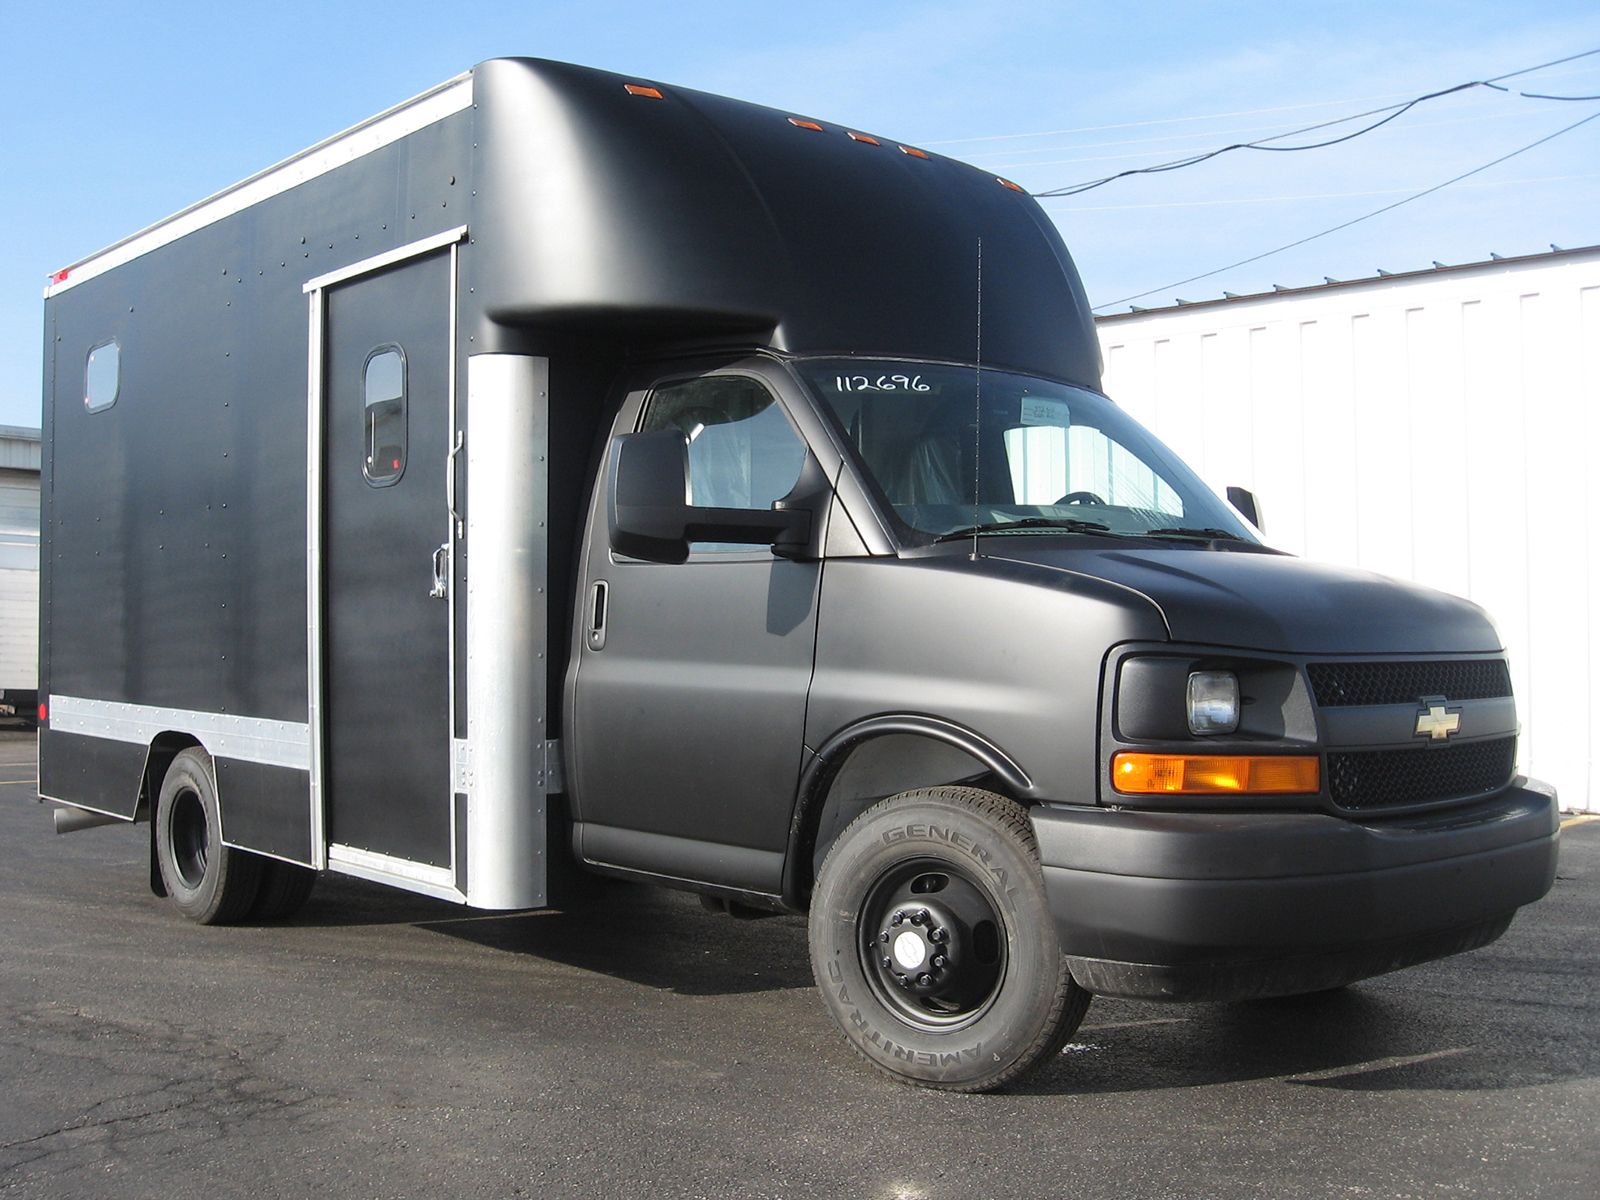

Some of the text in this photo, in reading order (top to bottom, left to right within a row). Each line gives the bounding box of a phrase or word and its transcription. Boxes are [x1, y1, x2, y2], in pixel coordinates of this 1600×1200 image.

[836, 375, 931, 392] 112696
[882, 824, 1018, 913] GENERAL
[827, 959, 982, 1068] AMERITRAC
